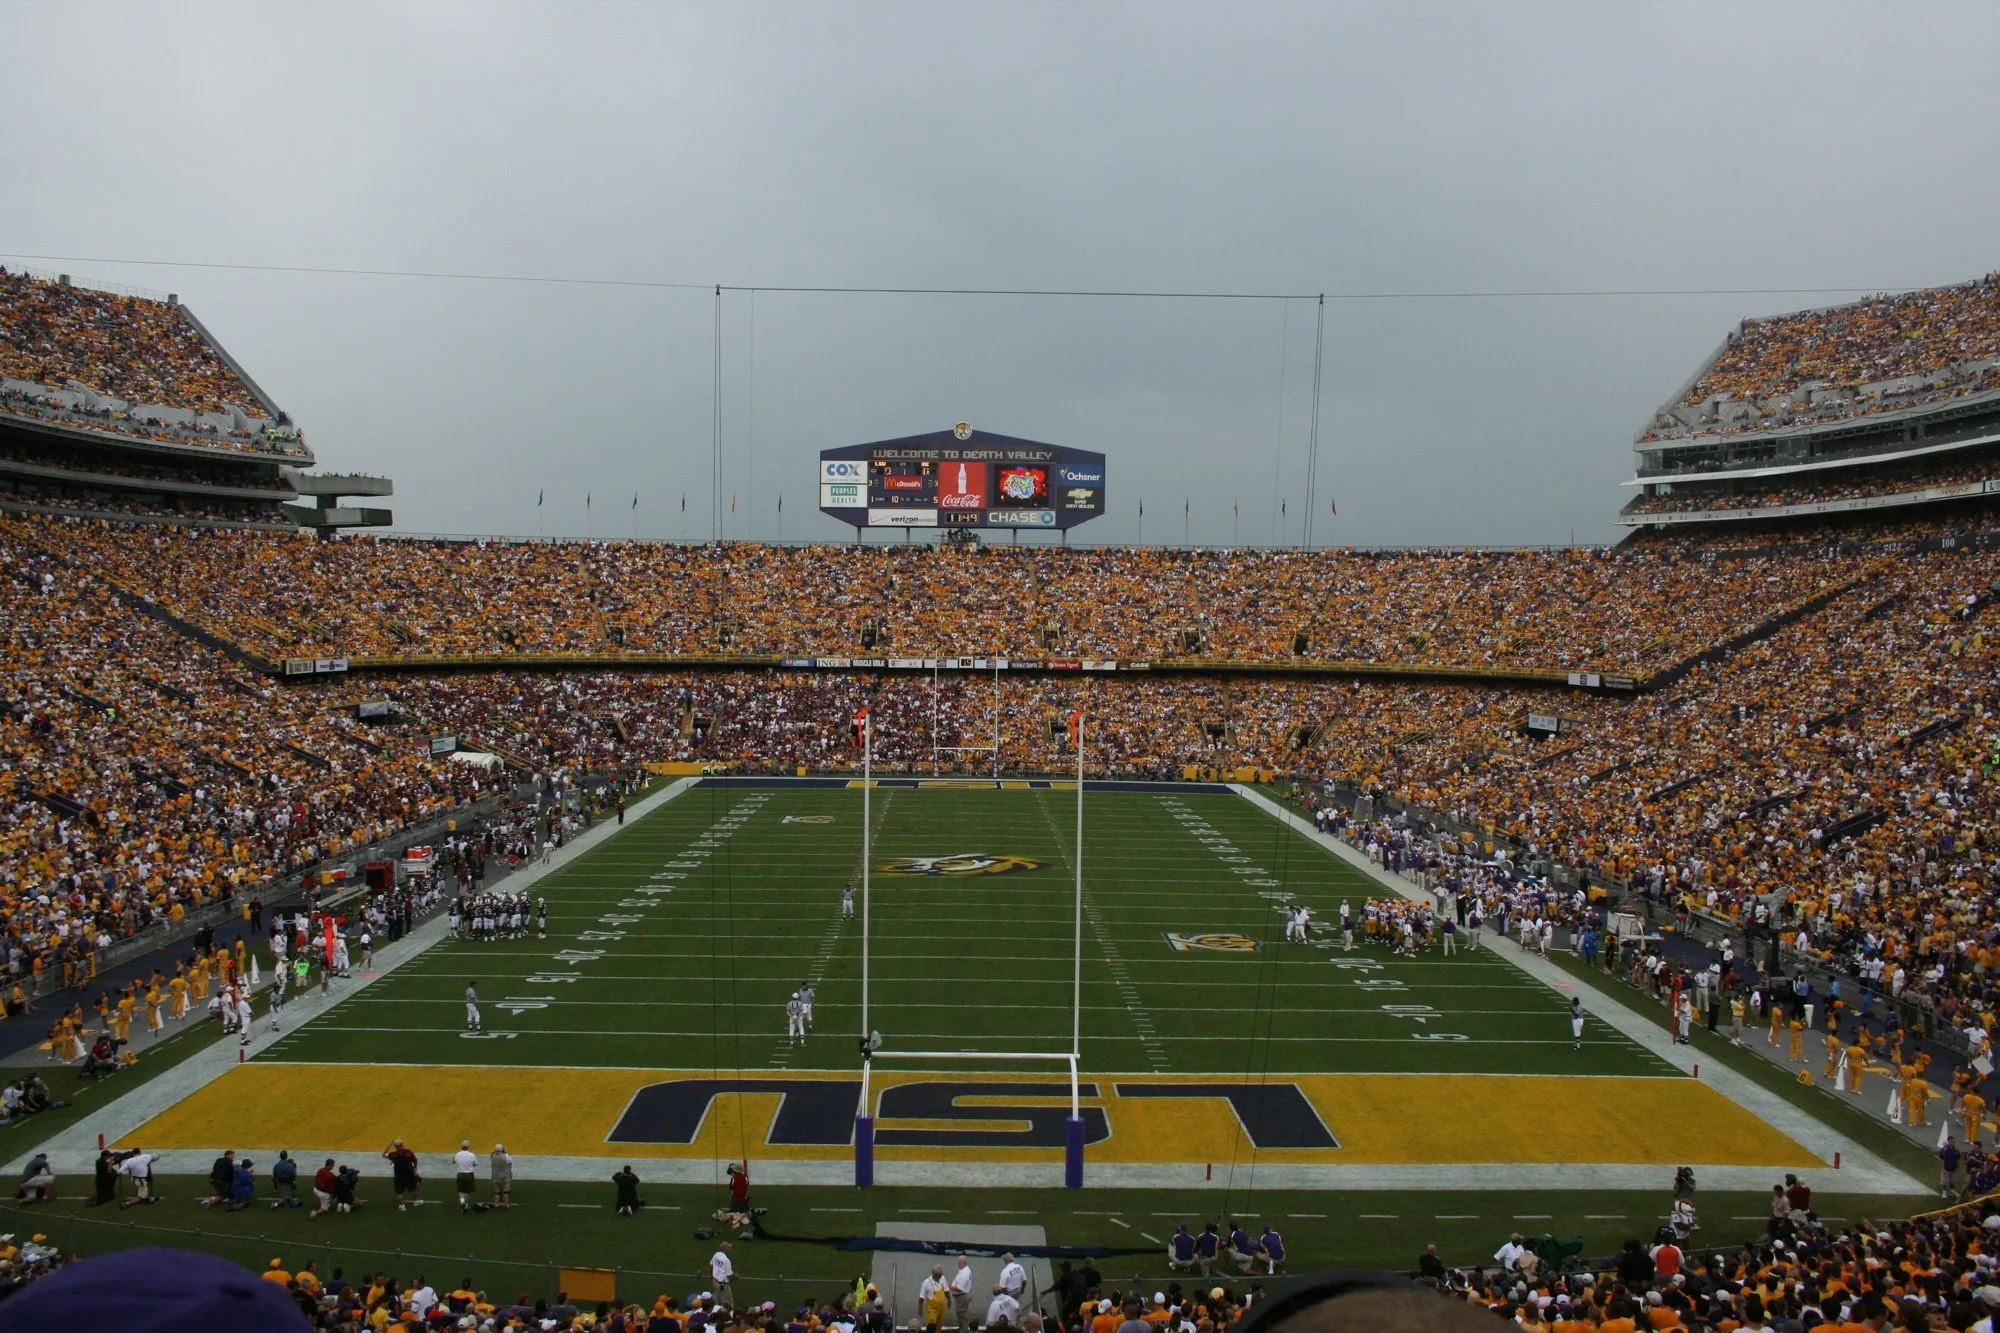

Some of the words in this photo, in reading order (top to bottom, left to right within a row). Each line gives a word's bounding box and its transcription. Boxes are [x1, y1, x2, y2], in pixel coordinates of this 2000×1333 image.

[873, 449, 939, 459] WELCOME
[943, 450, 959, 459] TO
[963, 451, 1003, 459] DEATH
[1005, 451, 1053, 460] VALLEY
[826, 463, 861, 476] COX
[1067, 472, 1100, 481] Ochsner
[989, 513, 1038, 523] CHASE
[817, 659, 836, 667] ING
[576, 930, 627, 941] 25
[552, 949, 607, 960] 20
[1329, 957, 1384, 969] 20
[525, 971, 582, 983] 15
[1353, 979, 1410, 991] 15
[494, 996, 557, 1009] 10
[1381, 1004, 1443, 1017] 10
[603, 1078, 1341, 1149] LSU
